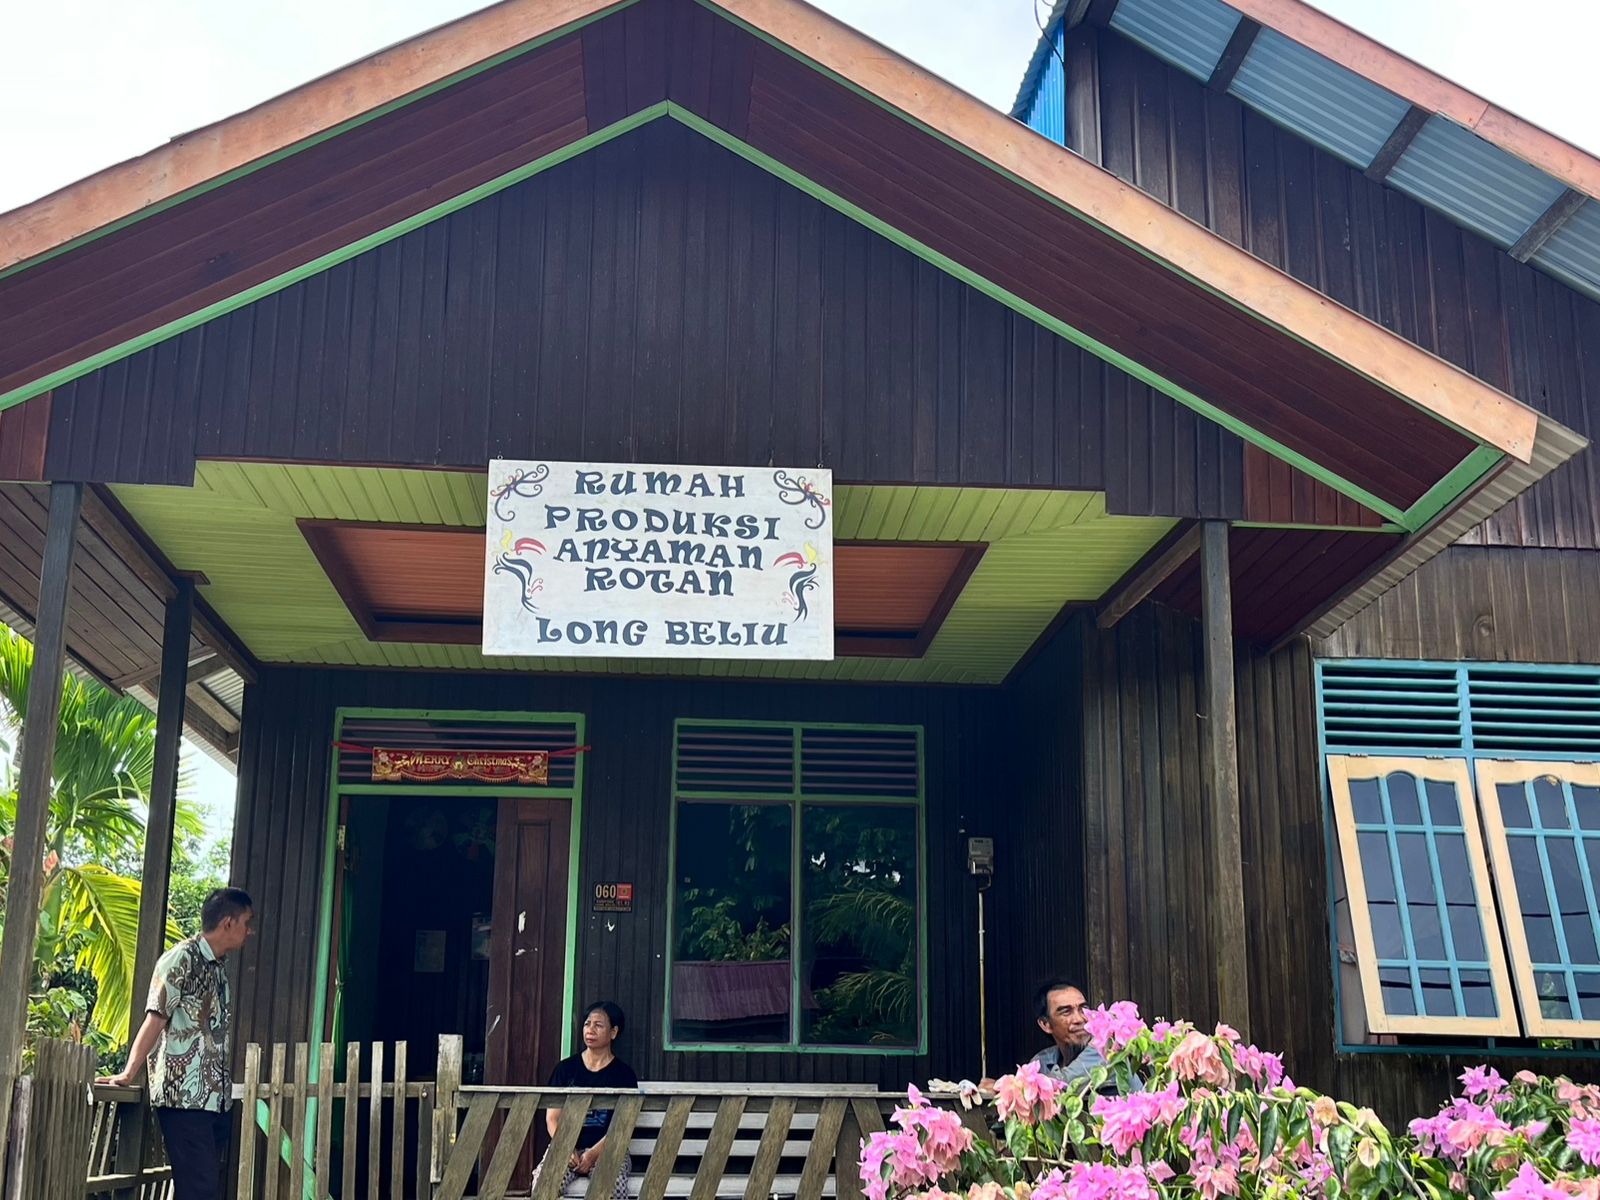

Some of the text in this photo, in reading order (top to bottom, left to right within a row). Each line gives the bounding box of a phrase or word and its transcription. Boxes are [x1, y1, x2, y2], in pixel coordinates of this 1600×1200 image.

[574, 470, 745, 498] RUMAH
[544, 504, 781, 540] PRODUKSI
[552, 537, 764, 571] ANYAMAN
[583, 567, 734, 597] ROTAN
[535, 617, 788, 647] LONG BELIU
[595, 884, 617, 899] 060
